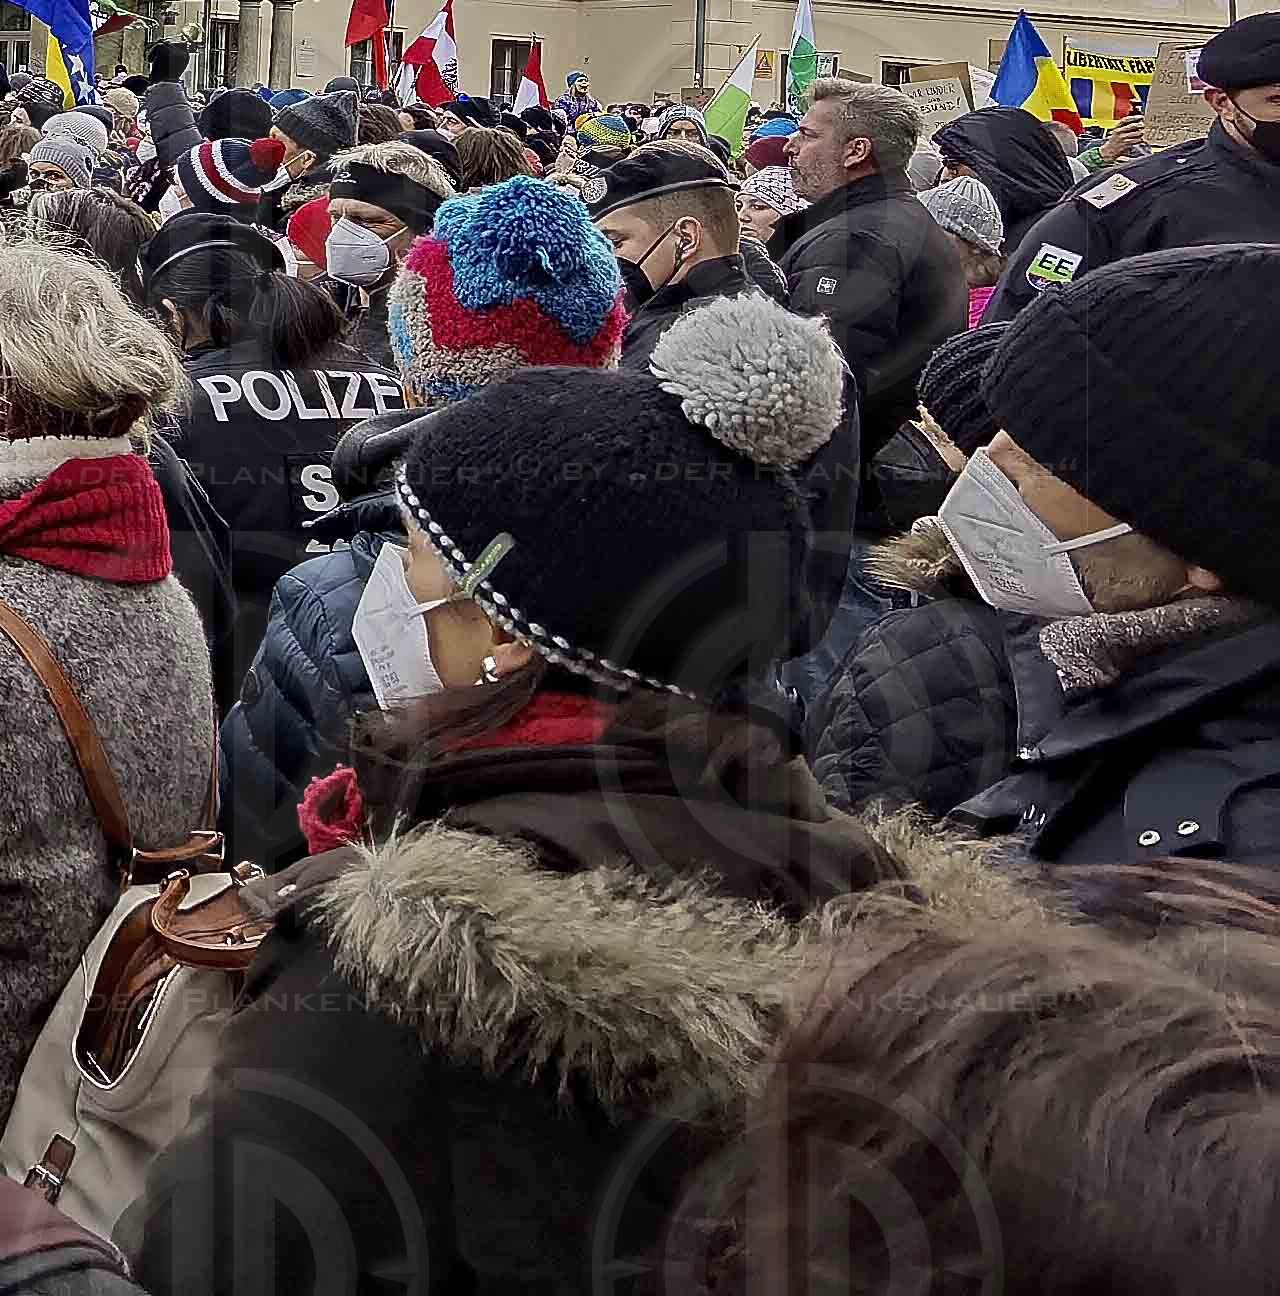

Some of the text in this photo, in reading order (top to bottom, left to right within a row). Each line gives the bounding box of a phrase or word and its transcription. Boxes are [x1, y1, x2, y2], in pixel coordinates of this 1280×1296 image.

[1066, 50, 1130, 73] LIBERTATE
[1038, 252, 1074, 277] EE
[196, 369, 407, 422] POLIZE
